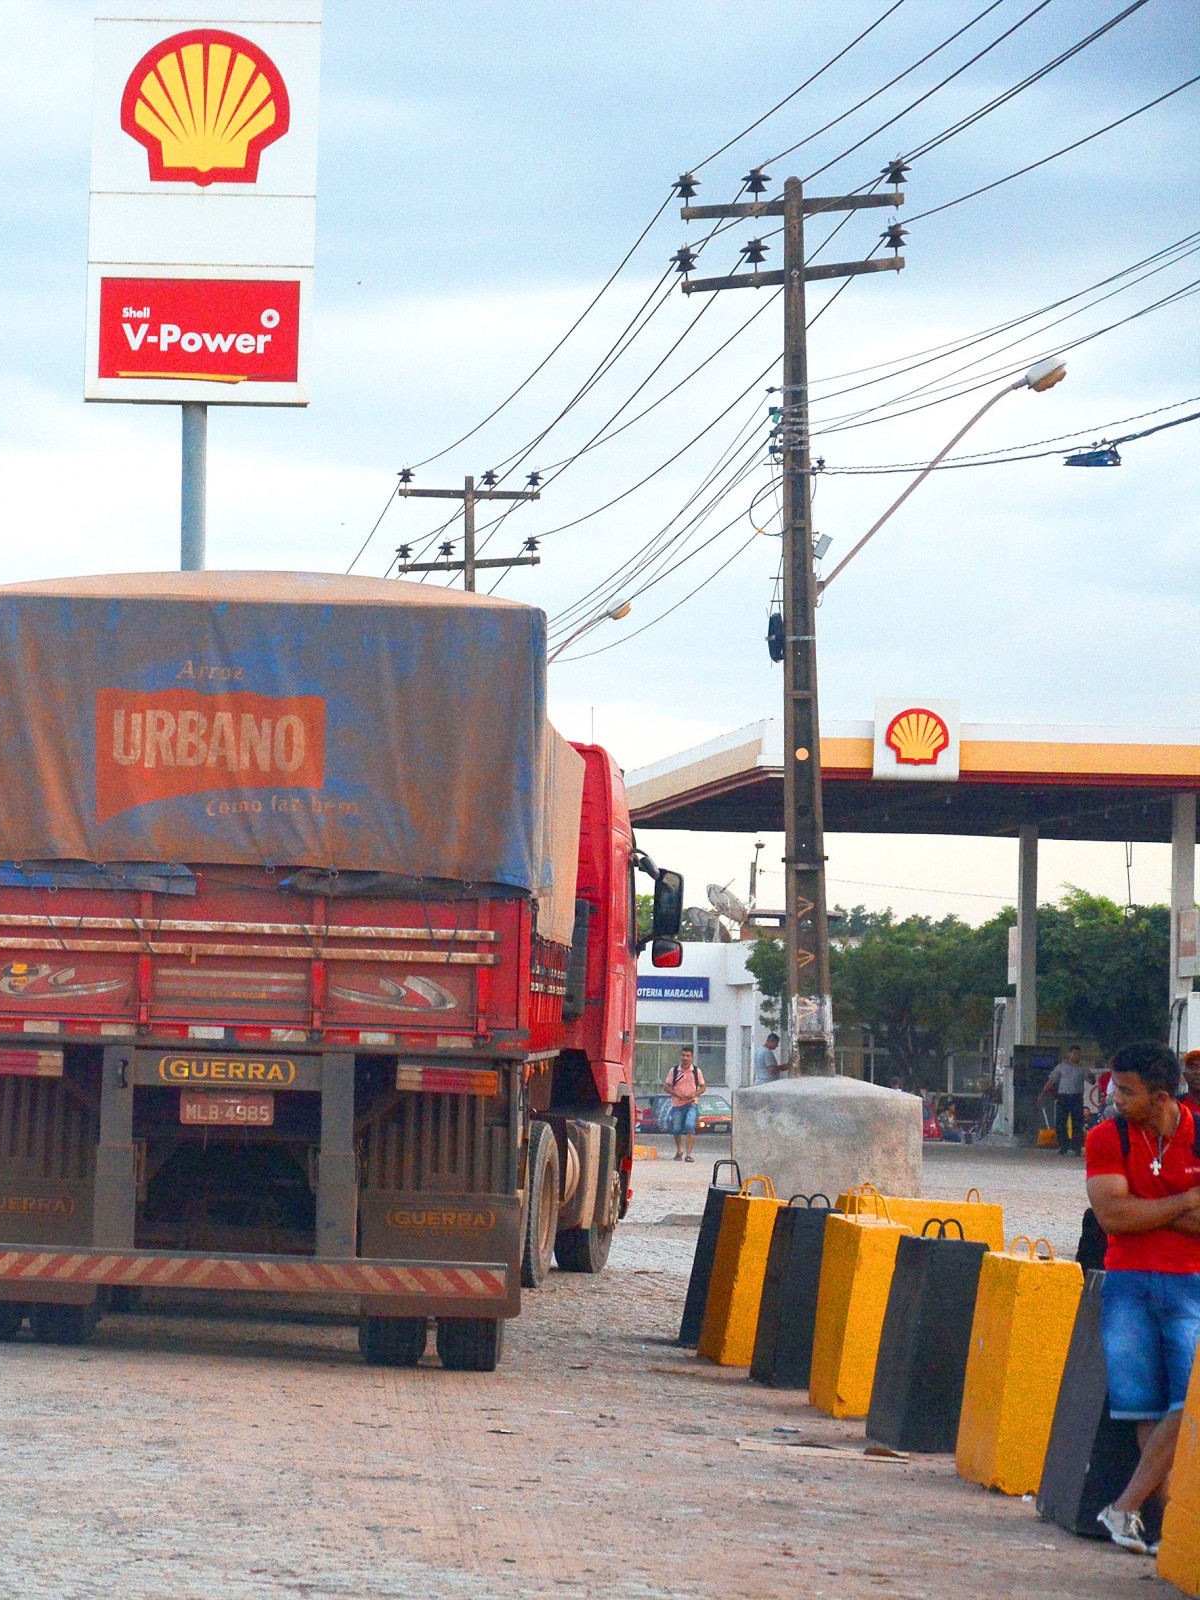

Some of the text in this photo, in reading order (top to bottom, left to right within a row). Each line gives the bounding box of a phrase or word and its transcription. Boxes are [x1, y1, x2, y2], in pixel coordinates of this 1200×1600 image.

[122, 306, 150, 318] Shell
[122, 323, 272, 354] V-Power
[176, 660, 246, 681] Arroz
[112, 709, 306, 773] URBANO
[205, 795, 359, 817] Como faz bem
[637, 987, 704, 998] OTERIA MARACANÁ
[169, 1060, 284, 1081] GUERRA
[394, 1209, 487, 1227] GUERRA
